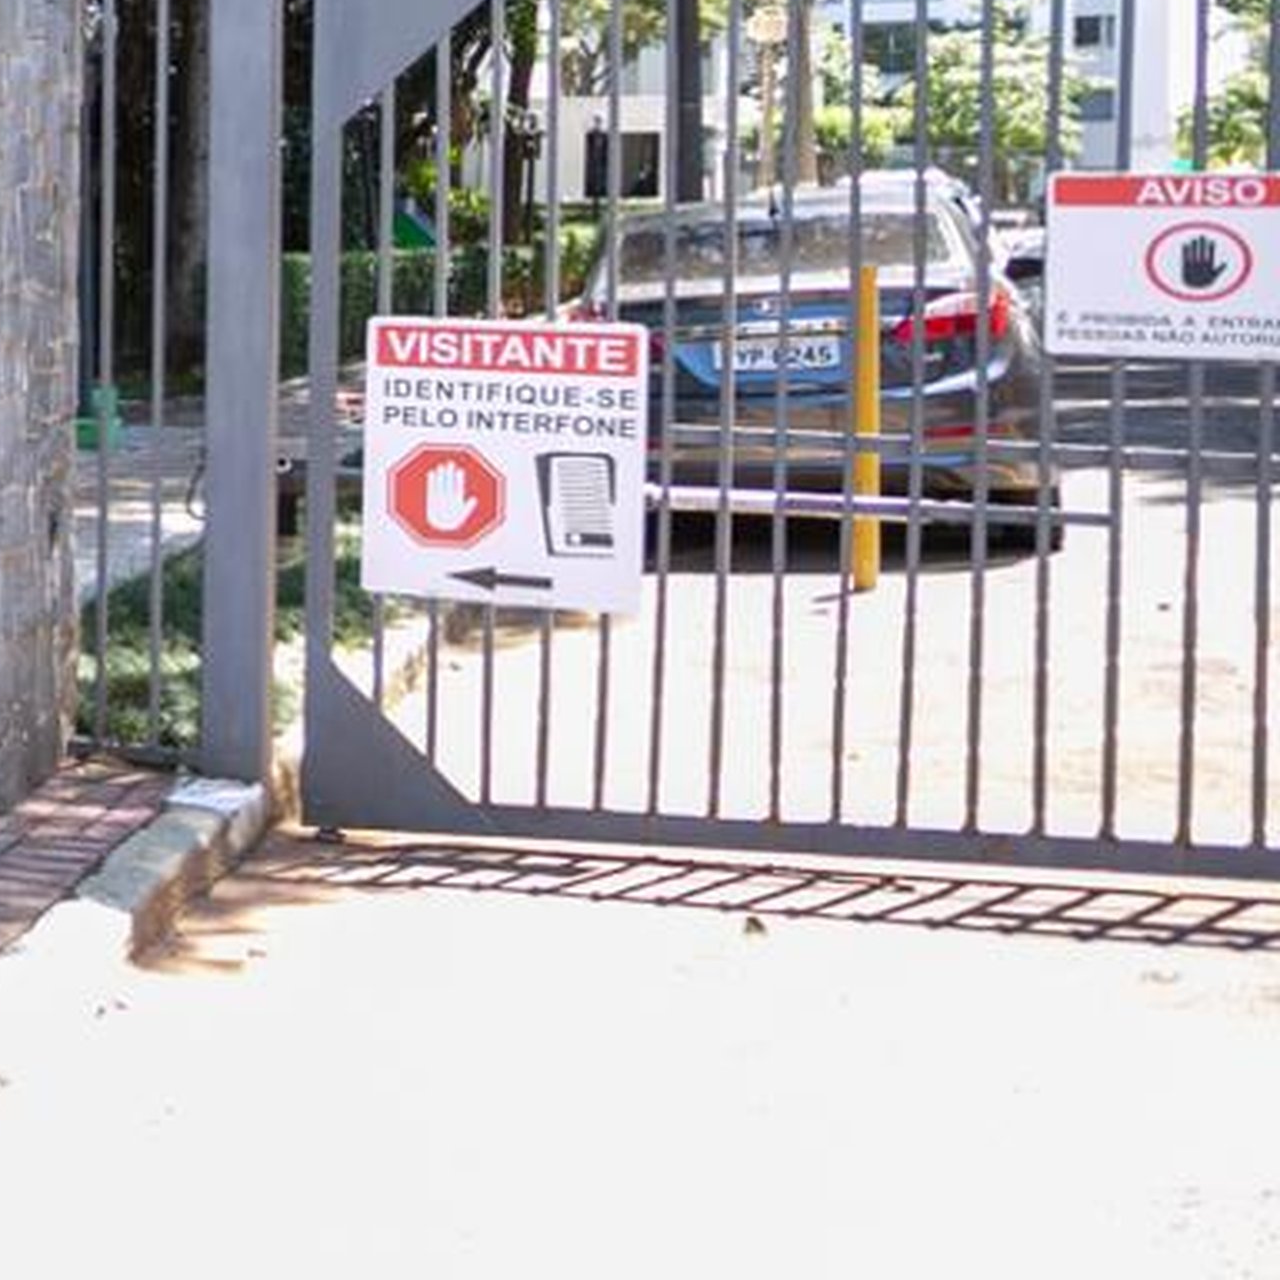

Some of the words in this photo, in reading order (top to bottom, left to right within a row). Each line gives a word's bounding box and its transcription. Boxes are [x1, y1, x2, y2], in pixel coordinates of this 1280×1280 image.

[1136, 178, 1267, 205] AVISO
[1151, 327, 1195, 345] NÃO
[1207, 316, 1280, 330] ENTRA
[386, 329, 629, 372] VISITANTE
[384, 378, 637, 411] IDENTIFIQUE-SE
[382, 405, 458, 428] PELO
[467, 409, 636, 438] INTERFONE
